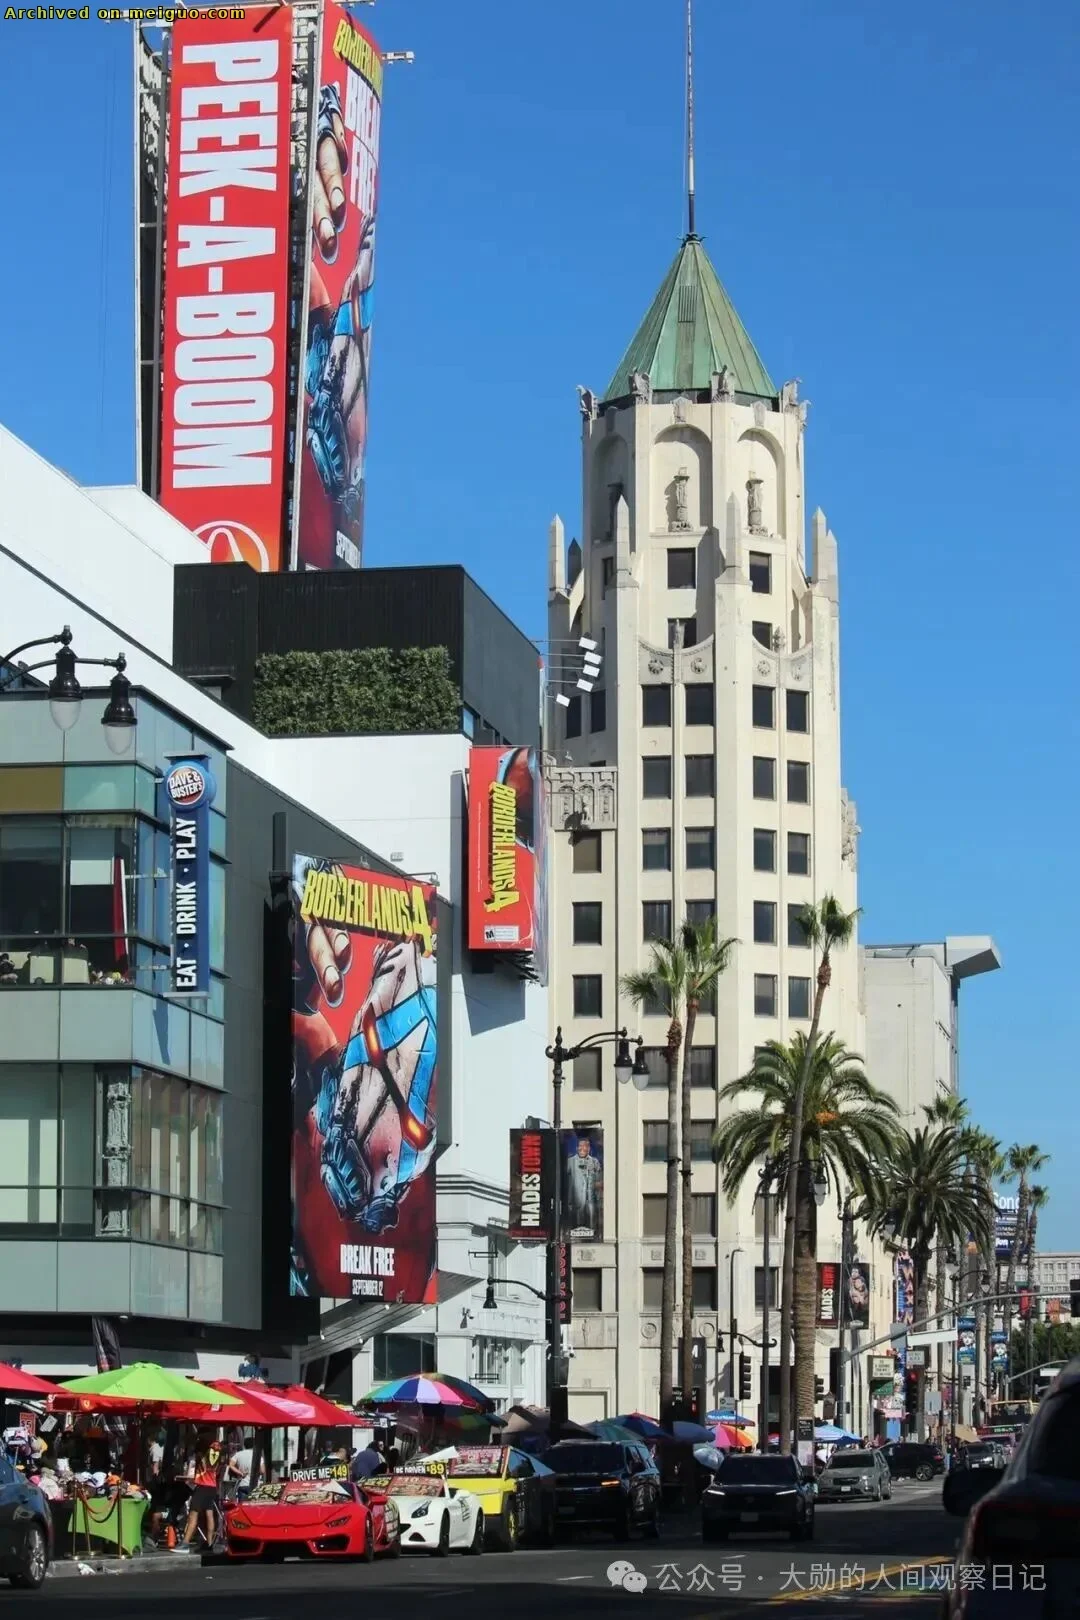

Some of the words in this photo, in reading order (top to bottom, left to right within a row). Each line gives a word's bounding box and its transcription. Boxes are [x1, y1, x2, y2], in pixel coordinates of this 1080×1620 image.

[171, 39, 280, 489] PEEK-A-BOOM
[169, 772, 193, 789] DAVE
[171, 782, 202, 798] BUSTER'S
[176, 817, 197, 859] PLAY
[491, 781, 517, 893] BORDERLANDS
[176, 881, 197, 935] DRINK
[300, 869, 413, 937] BORDERLANDS
[412, 886, 433, 955] 4
[485, 888, 520, 912] 4
[485, 929, 495, 939] M
[176, 957, 197, 987] EAT
[521, 1134, 541, 1227] HADESTOWN
[340, 1244, 372, 1275] BREAK
[373, 1246, 395, 1276] FREE
[352, 1279, 378, 1296] SEPTEMBER
[292, 1468, 317, 1482] DRIVE
[318, 1466, 330, 1479] ME
